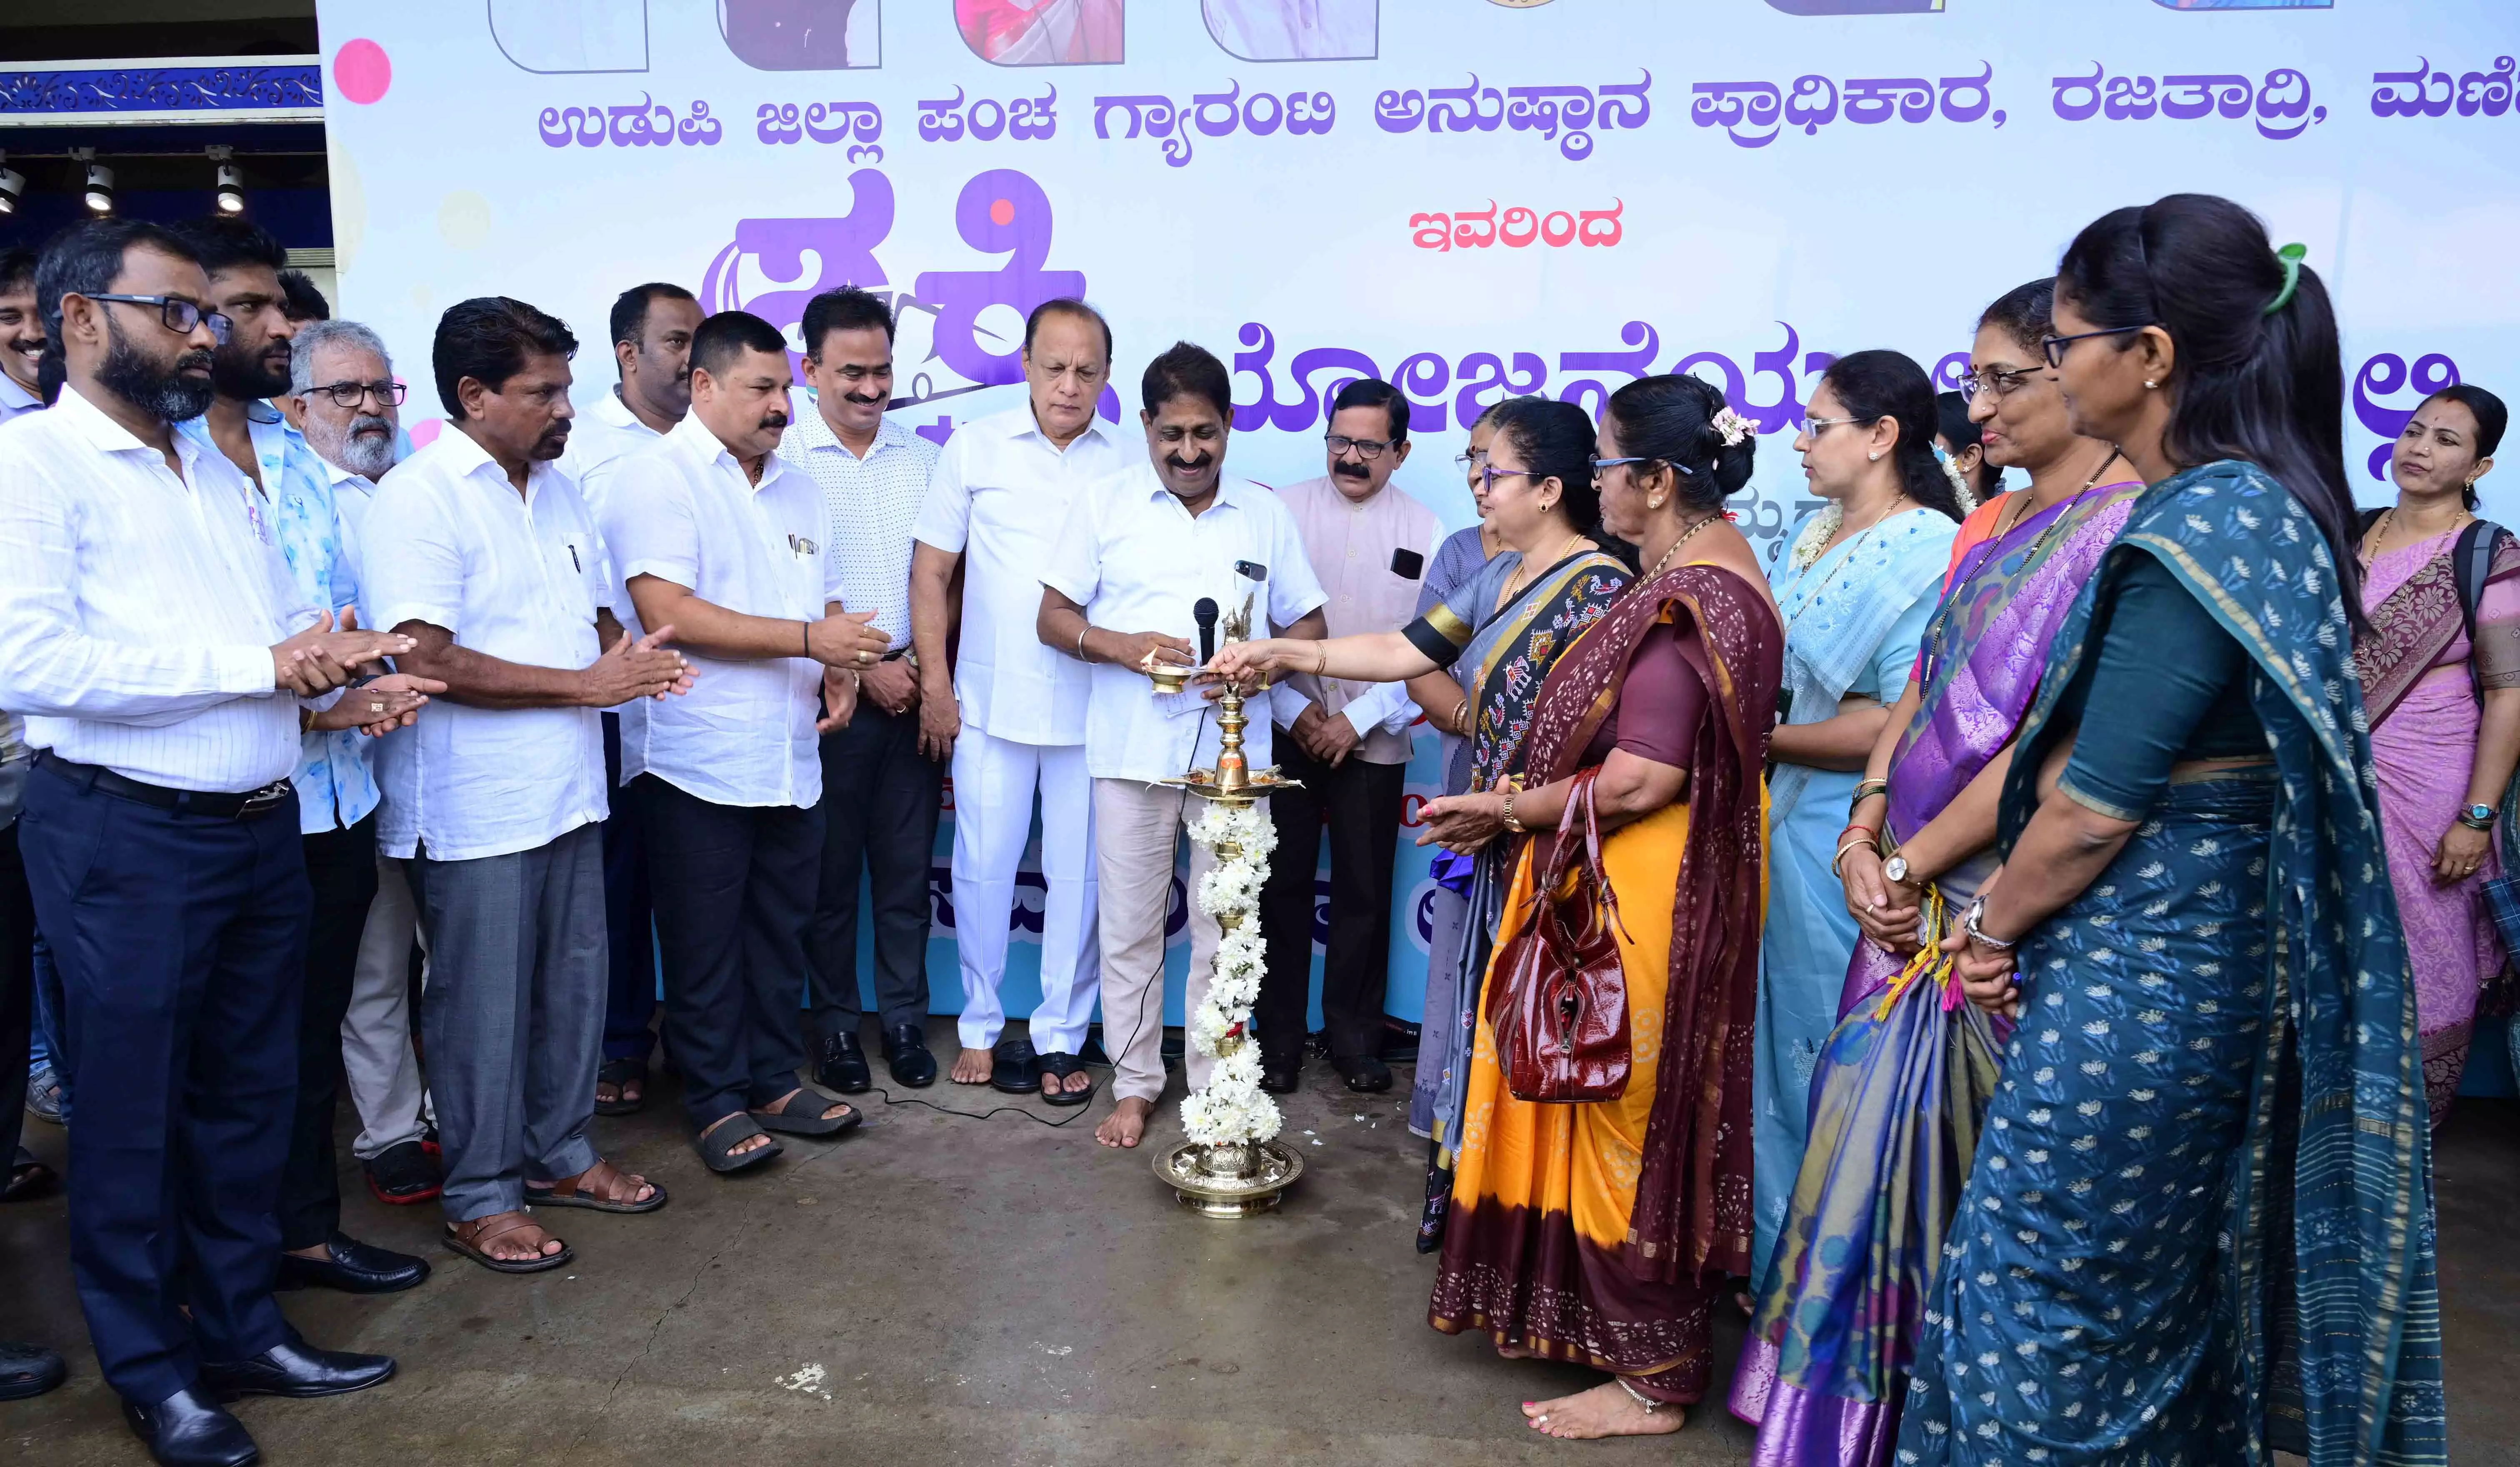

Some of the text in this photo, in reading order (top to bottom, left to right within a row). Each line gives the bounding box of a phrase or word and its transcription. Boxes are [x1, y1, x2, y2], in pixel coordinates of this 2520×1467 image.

[539, 55, 2520, 168] ಉಡುಪಿ ಜಿಲ್ಲಾ ಪಂಚ ಗ್ಯಾರಂಟಿ ಅನುಷ್ಠಾನ ಪ್ರಾಧಿಕಾರ, ರಜತಾದ್ರಿ, ಮಣಿ
[1409, 197, 1624, 253] ಇವರಿಂದ
